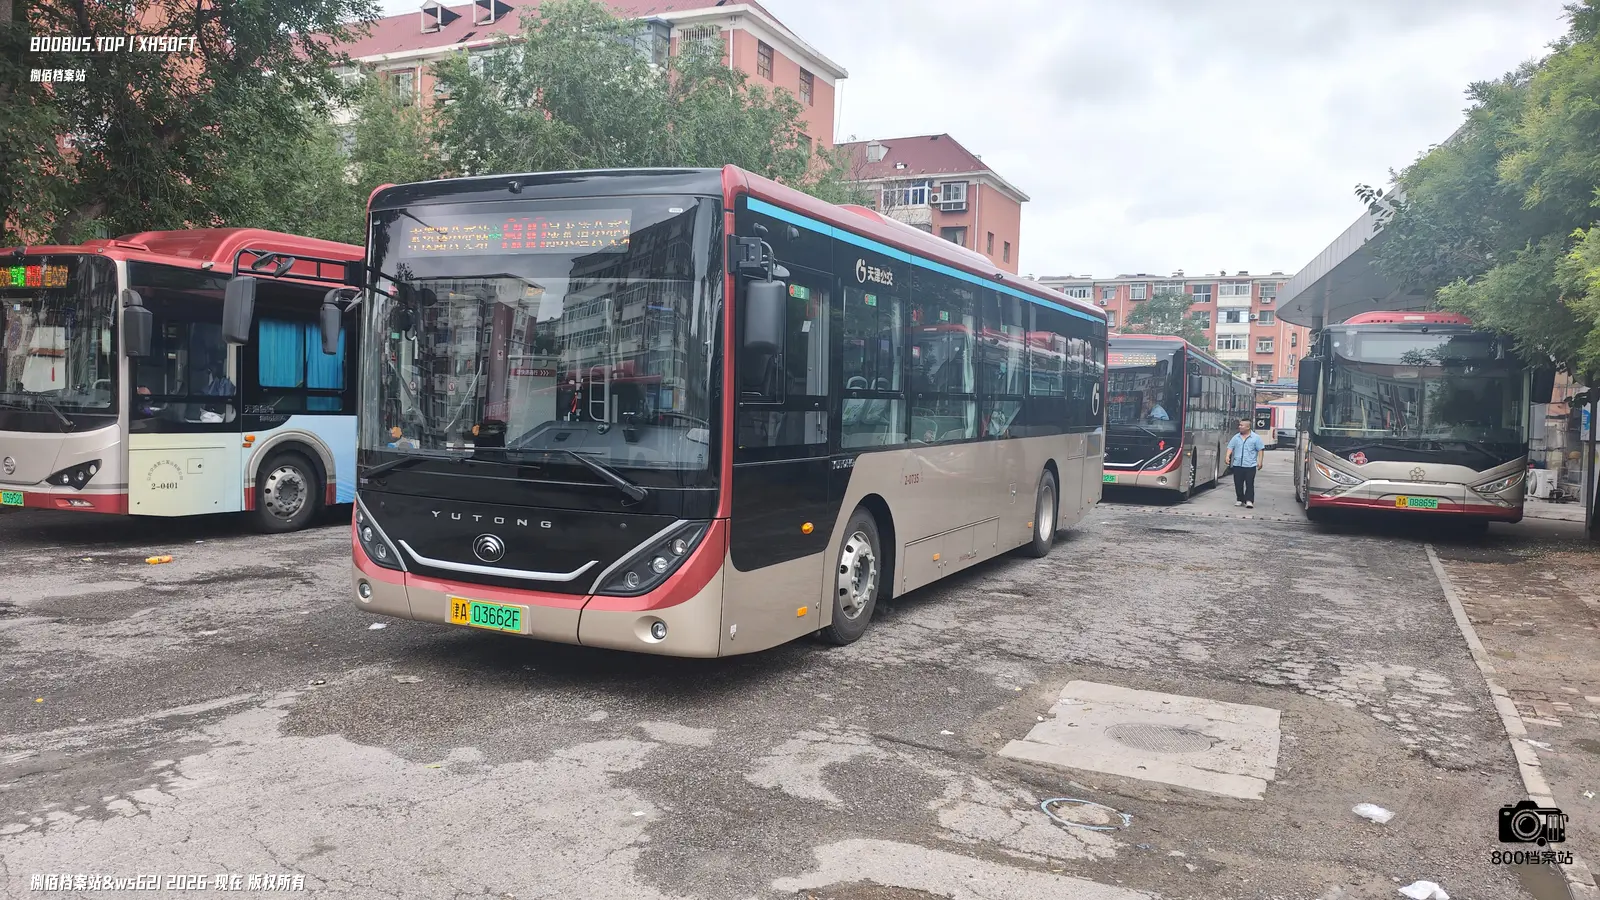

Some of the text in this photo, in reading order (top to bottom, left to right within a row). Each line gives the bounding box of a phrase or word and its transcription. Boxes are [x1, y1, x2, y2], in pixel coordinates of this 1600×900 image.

[867, 265, 893, 287] 天津公交
[151, 482, 178, 490] 2-0401
[431, 510, 552, 529] YUTONG
[473, 604, 520, 629] 03662F
